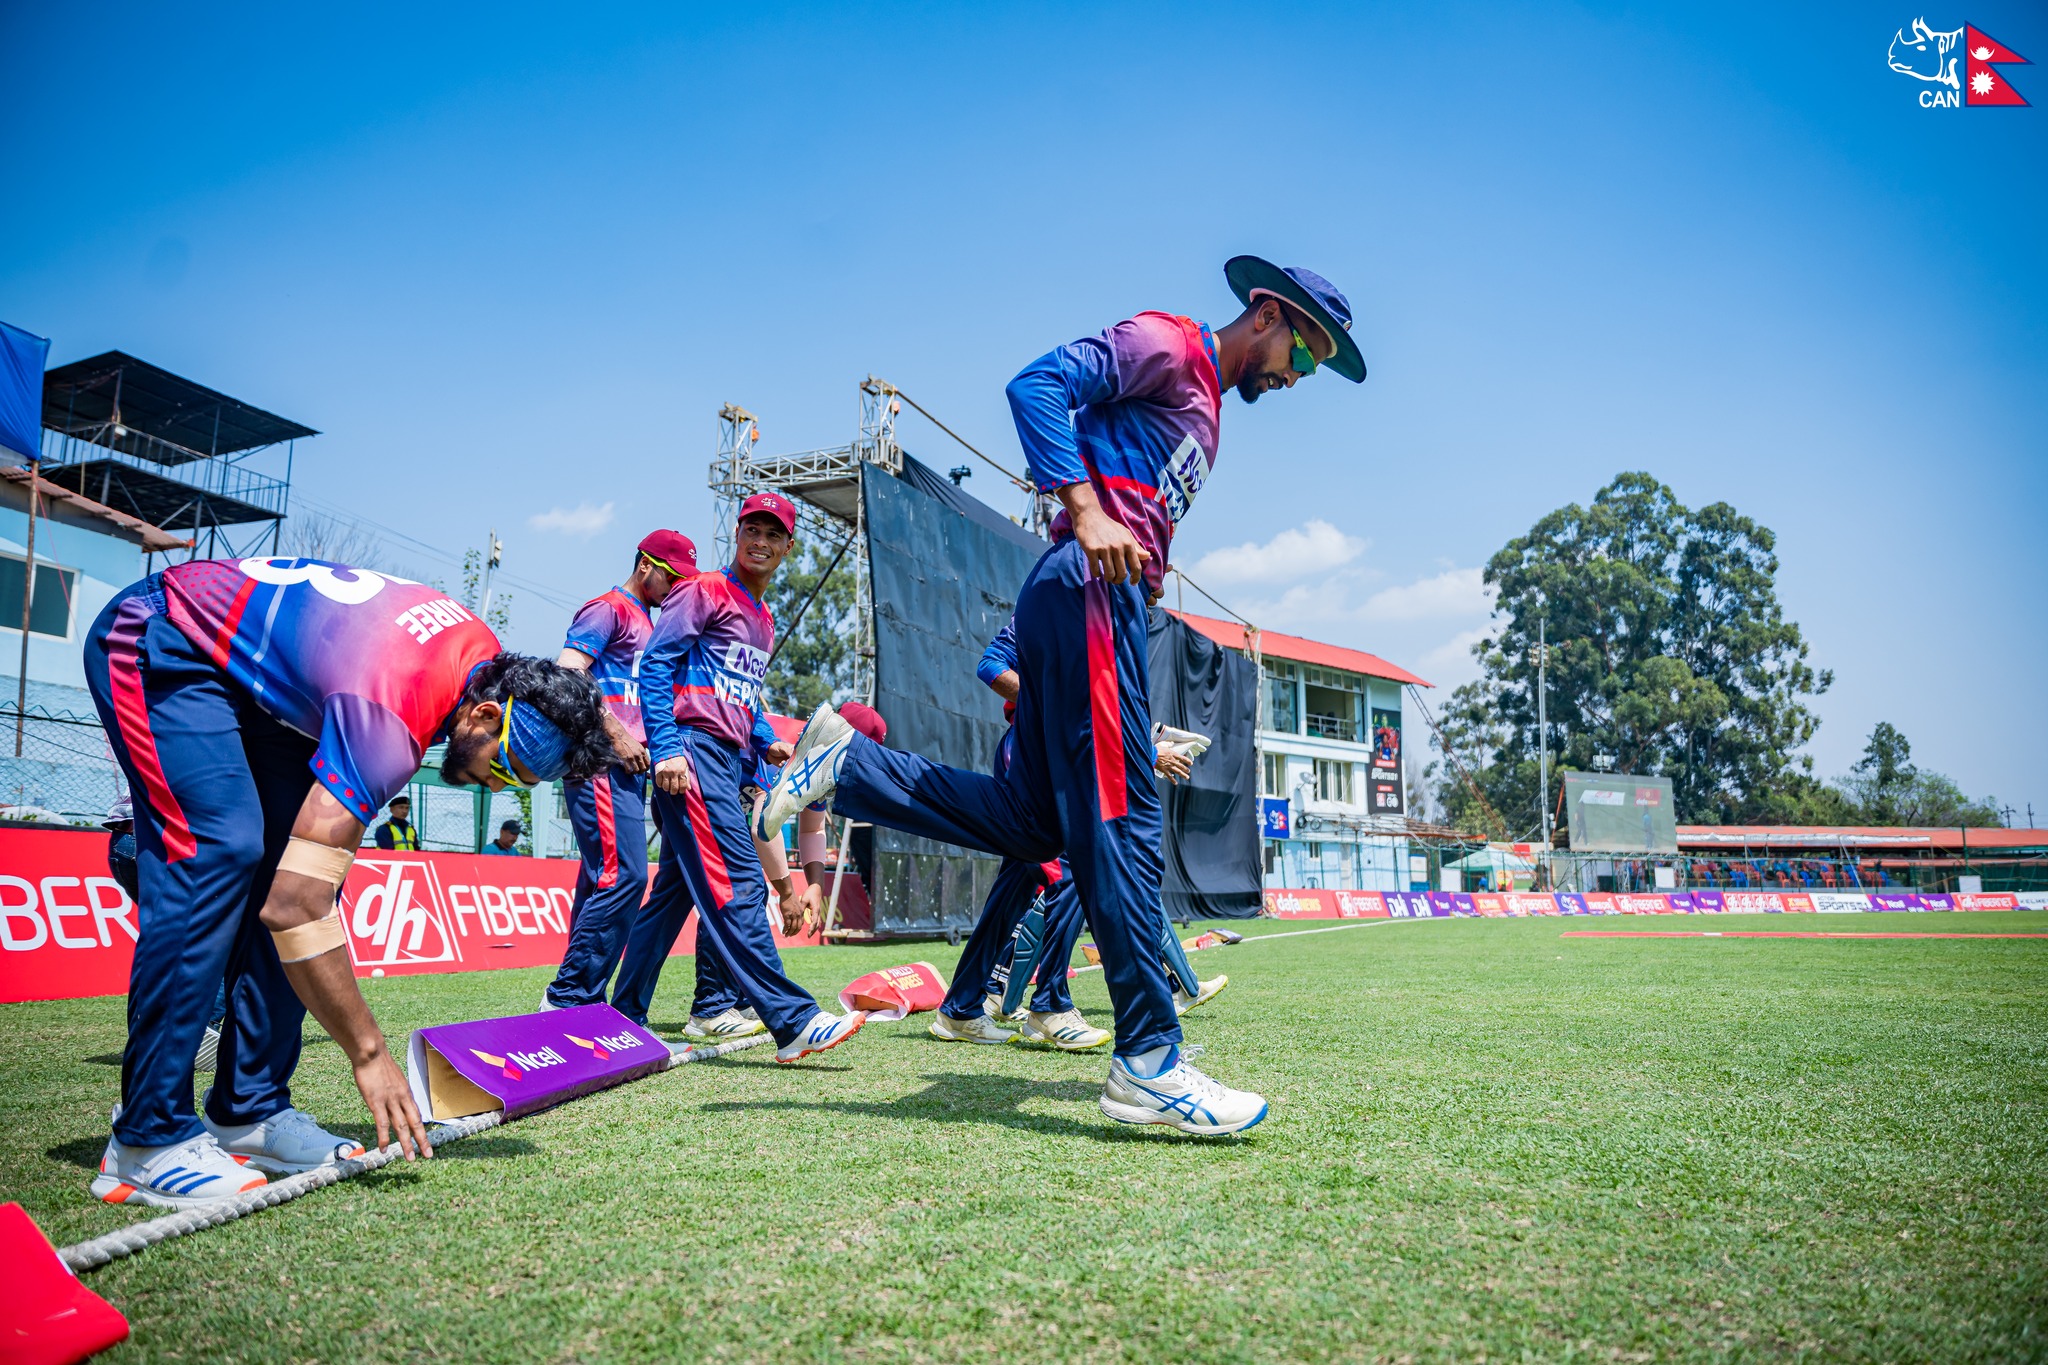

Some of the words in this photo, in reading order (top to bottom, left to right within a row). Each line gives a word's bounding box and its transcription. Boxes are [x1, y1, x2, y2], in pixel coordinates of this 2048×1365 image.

[394, 598, 474, 645] AIREE
[352, 862, 428, 962] dh
[506, 1045, 567, 1072] Ncell
[593, 1030, 644, 1053] Ncell
